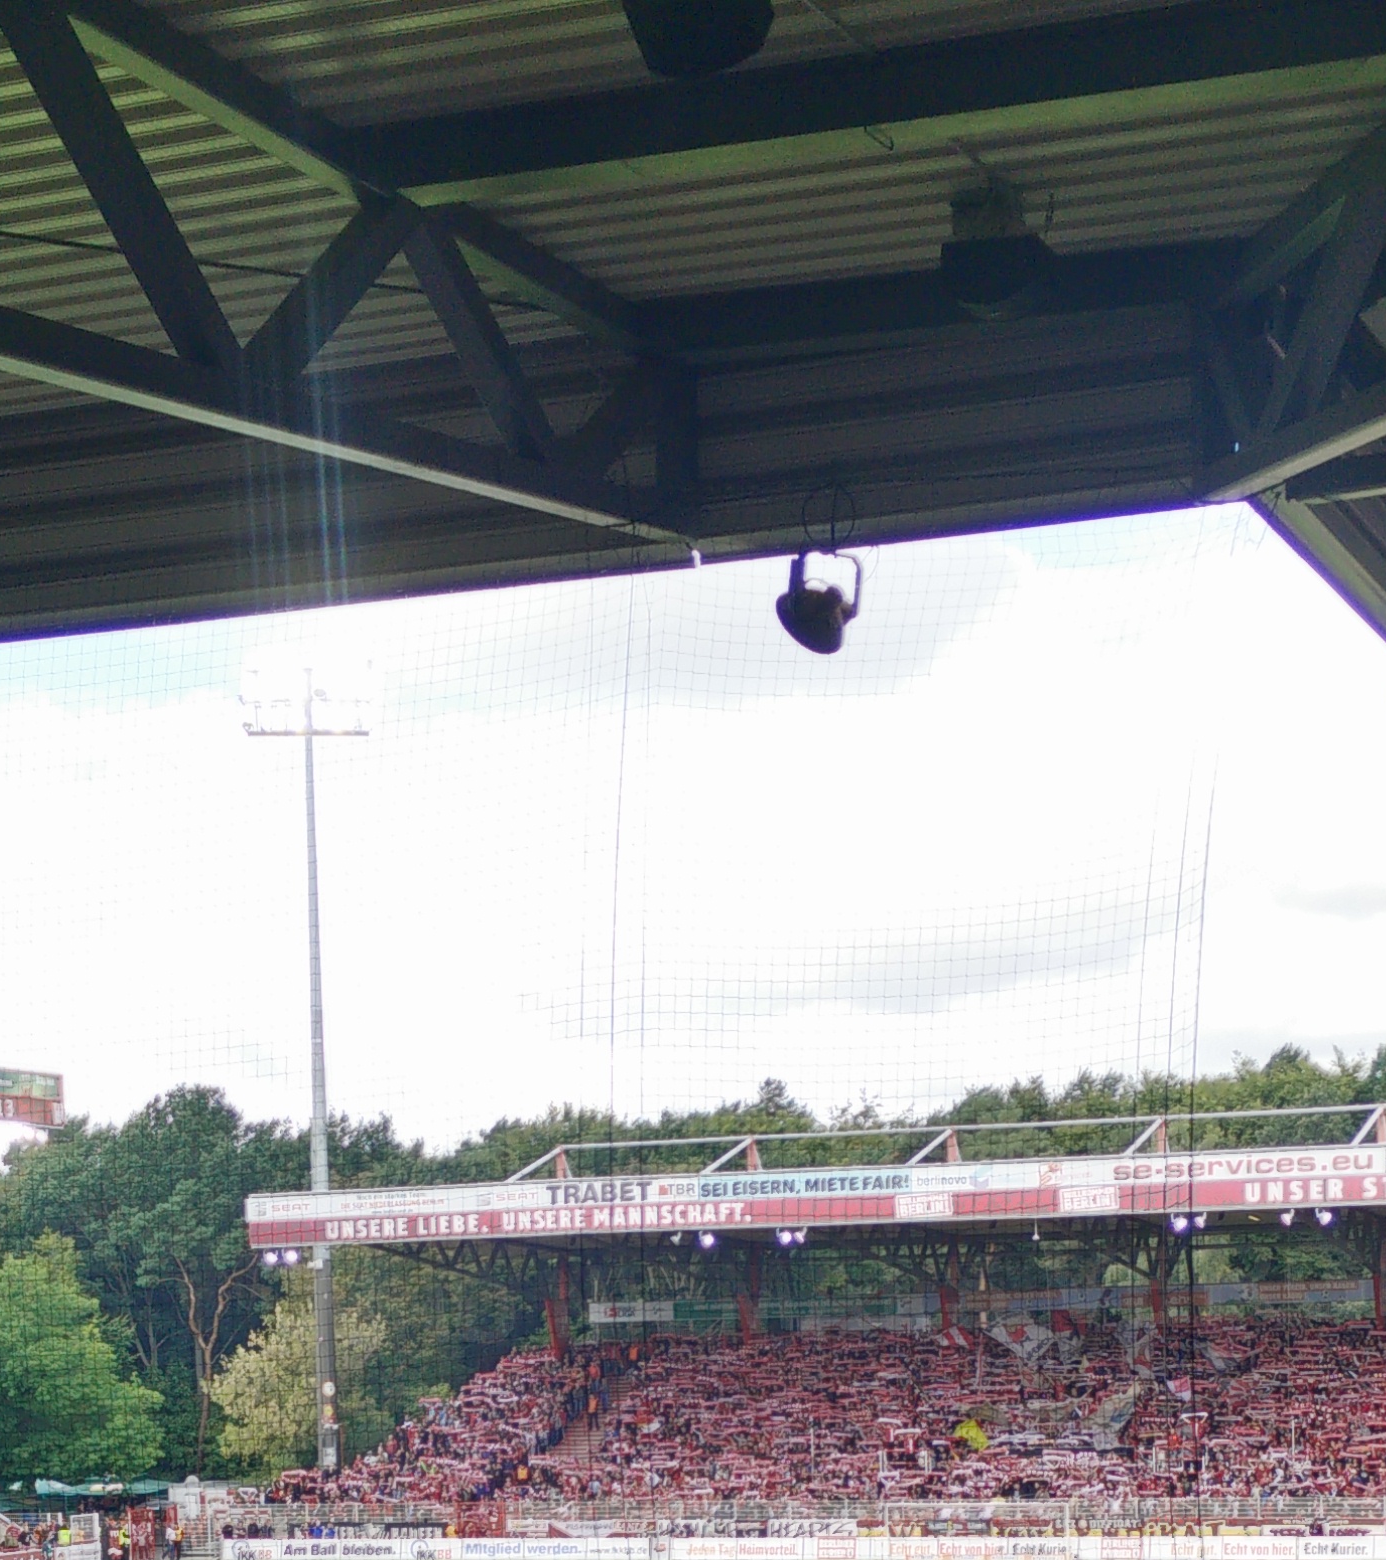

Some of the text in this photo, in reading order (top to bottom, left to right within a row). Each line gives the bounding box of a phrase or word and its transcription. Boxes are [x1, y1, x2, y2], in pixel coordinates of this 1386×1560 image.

[1113, 1153, 1374, 1181] se-services.eu
[546, 1181, 653, 1205] TRABET
[700, 1174, 910, 1198] SEI EISERN, MIETE FAIR!
[1244, 1178, 1343, 1203] UNSER
[496, 1191, 538, 1202] SEAT
[1063, 1195, 1117, 1211] BERLIN!
[271, 1203, 311, 1213] SEAT
[899, 1201, 951, 1217] BERLIN!
[325, 1202, 751, 1240] UNSERE LIEBE. UNSERE MANNSCHAFT.
[284, 1543, 396, 1556] Am Ball bleiben.
[465, 1543, 582, 1557] Mitglied werden.
[687, 1544, 715, 1555] Jeden
[718, 1544, 735, 1557] Tag
[939, 1543, 961, 1555] Echt
[964, 1546, 983, 1555] von
[1039, 1543, 1068, 1555] Kurie
[1224, 1543, 1247, 1556] Echt
[1251, 1546, 1266, 1556] von
[1268, 1543, 1295, 1556] hier.
[1304, 1543, 1328, 1555] Echt
[1331, 1543, 1369, 1555] Kurier.
